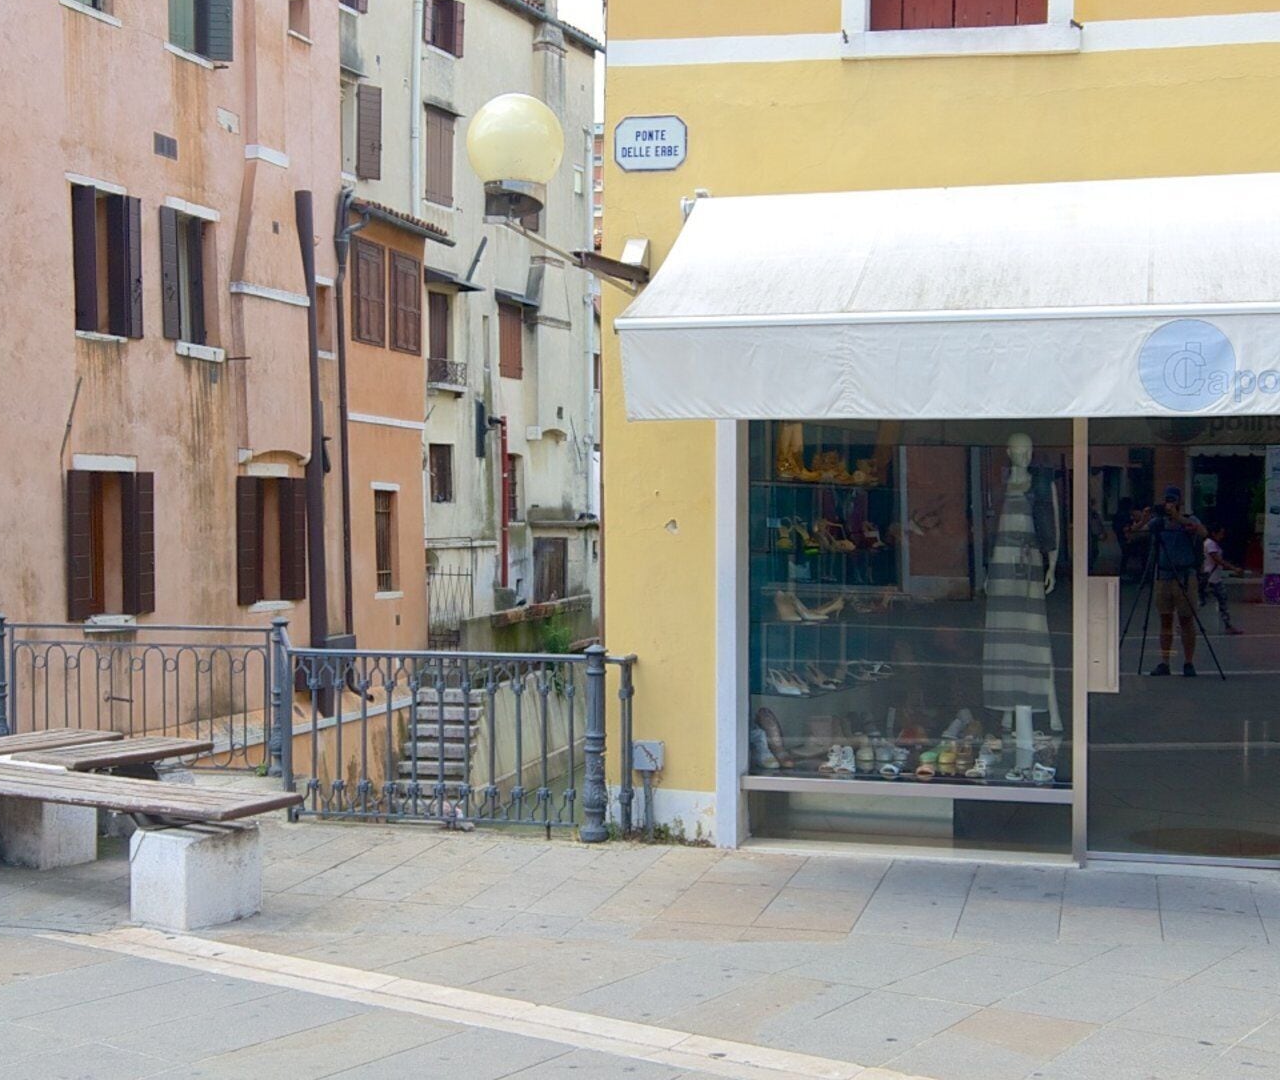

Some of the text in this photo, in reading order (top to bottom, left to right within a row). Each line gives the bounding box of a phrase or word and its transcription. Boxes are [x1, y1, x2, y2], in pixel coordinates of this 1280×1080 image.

[635, 129, 667, 142] PONTE
[621, 145, 680, 158] DELLE ERBE
